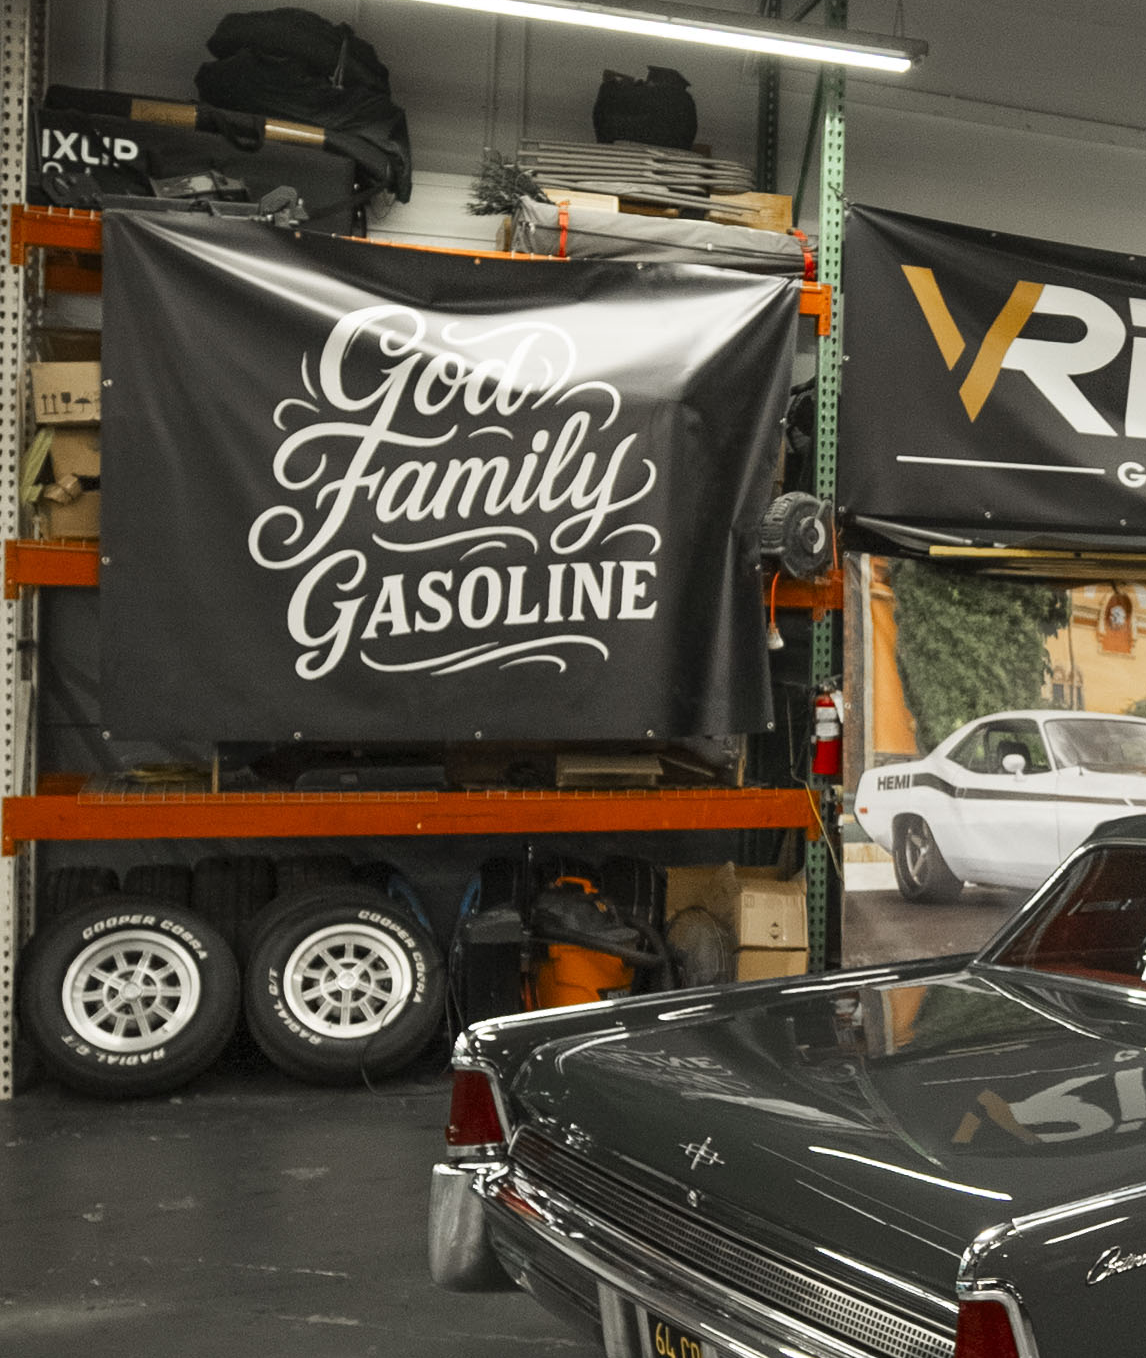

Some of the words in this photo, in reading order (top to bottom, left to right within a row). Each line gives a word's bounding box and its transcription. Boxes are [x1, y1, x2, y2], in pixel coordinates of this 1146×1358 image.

[319, 304, 577, 423] God
[248, 410, 657, 570] Family
[287, 549, 658, 680] GASOLINE
[877, 774, 911, 791] HEMI
[82, 914, 157, 940] COOPER
[160, 919, 208, 960] COBRA
[358, 909, 416, 949] COOPER
[412, 951, 426, 1003] COBRA
[98, 1047, 166, 1066] RADIAL
[274, 1000, 322, 1045] RADIAL
